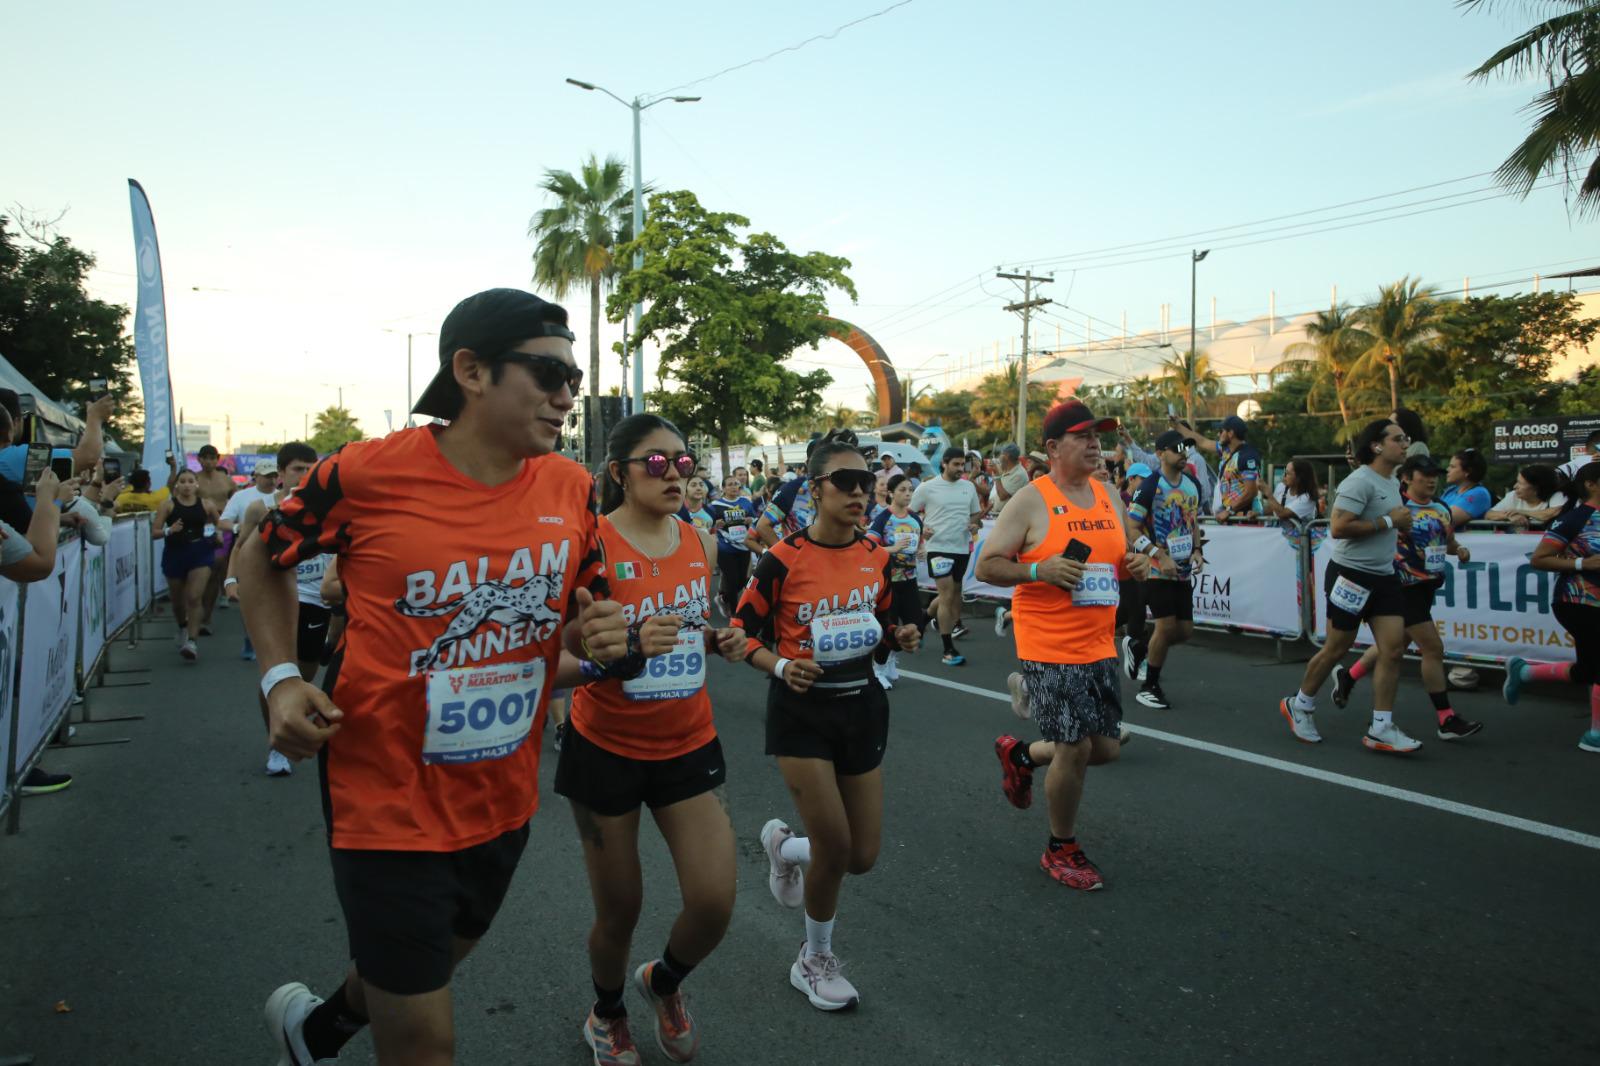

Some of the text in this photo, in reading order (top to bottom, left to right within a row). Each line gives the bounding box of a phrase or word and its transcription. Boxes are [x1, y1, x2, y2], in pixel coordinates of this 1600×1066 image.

[1495, 426, 1509, 437] EL
[1512, 423, 1558, 436] ACOSO
[1495, 440, 1559, 450] ES UN DELITO
[405, 539, 570, 609] BALAM
[1432, 553, 1558, 614] ATLÁ
[621, 576, 708, 628] BALAM
[798, 582, 879, 622] BALAM
[1193, 595, 1231, 612] TLÁN
[1334, 585, 1364, 606] 5391
[819, 628, 878, 653] 6658
[1453, 621, 1576, 648] HISTORIAS
[407, 621, 557, 678] RUNNERS
[659, 690, 681, 699] MAJA
[437, 687, 538, 734] 5001
[481, 746, 508, 759] MAJA
